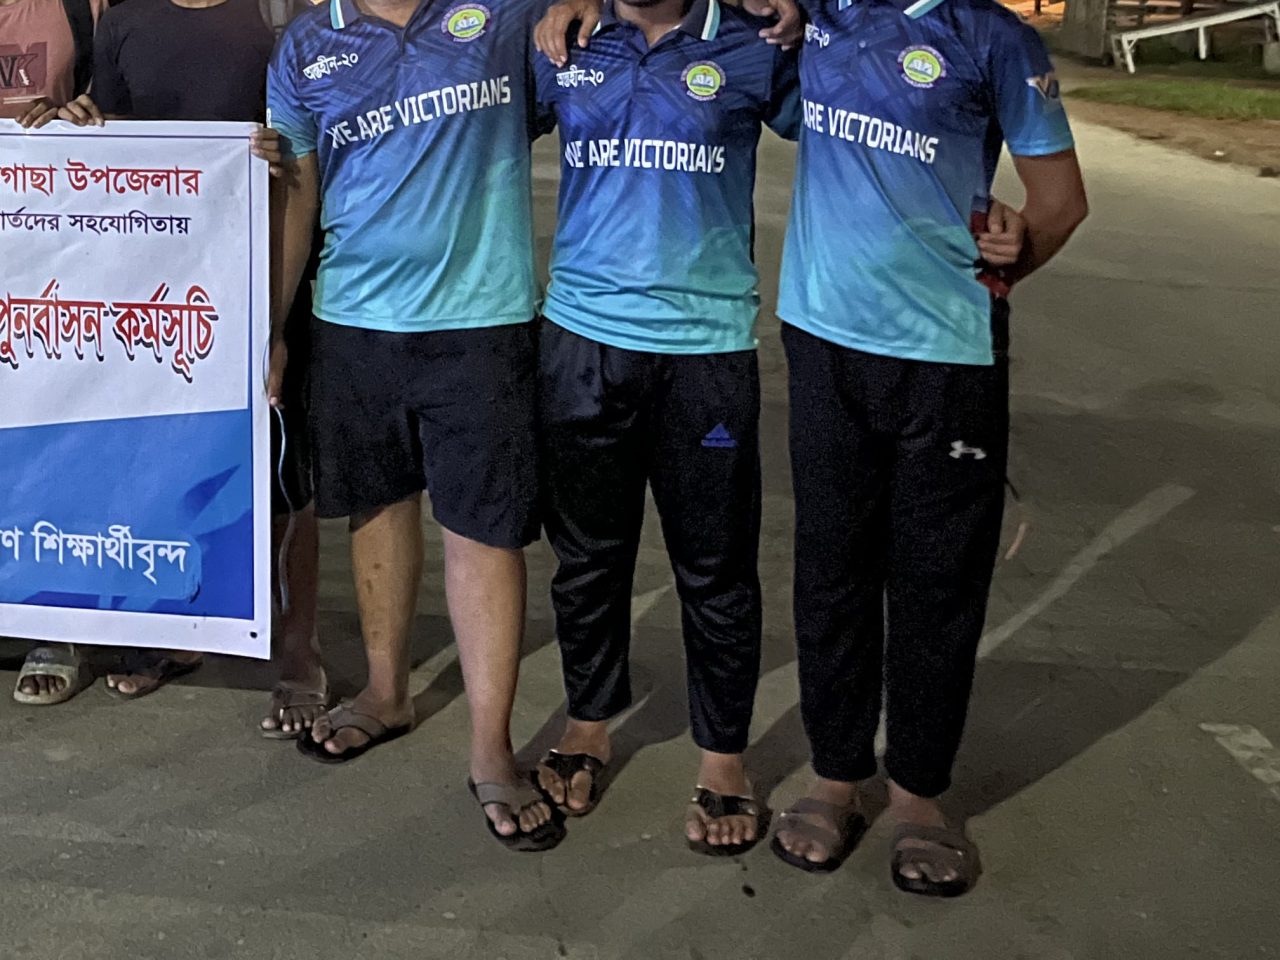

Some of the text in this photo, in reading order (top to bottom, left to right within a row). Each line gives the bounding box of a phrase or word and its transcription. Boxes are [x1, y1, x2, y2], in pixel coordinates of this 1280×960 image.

[356, 105, 395, 141] ARE
[394, 75, 512, 128] VICTORIANS
[827, 106, 940, 164] VICTORIANS
[63, 157, 204, 197] উপজেলার
[588, 138, 621, 167] ARE
[67, 210, 192, 236] সহযোগিতায়
[111, 282, 220, 384] কর্মসূচি
[30, 520, 191, 585] শিক্ষার্থীবৃন্দ
